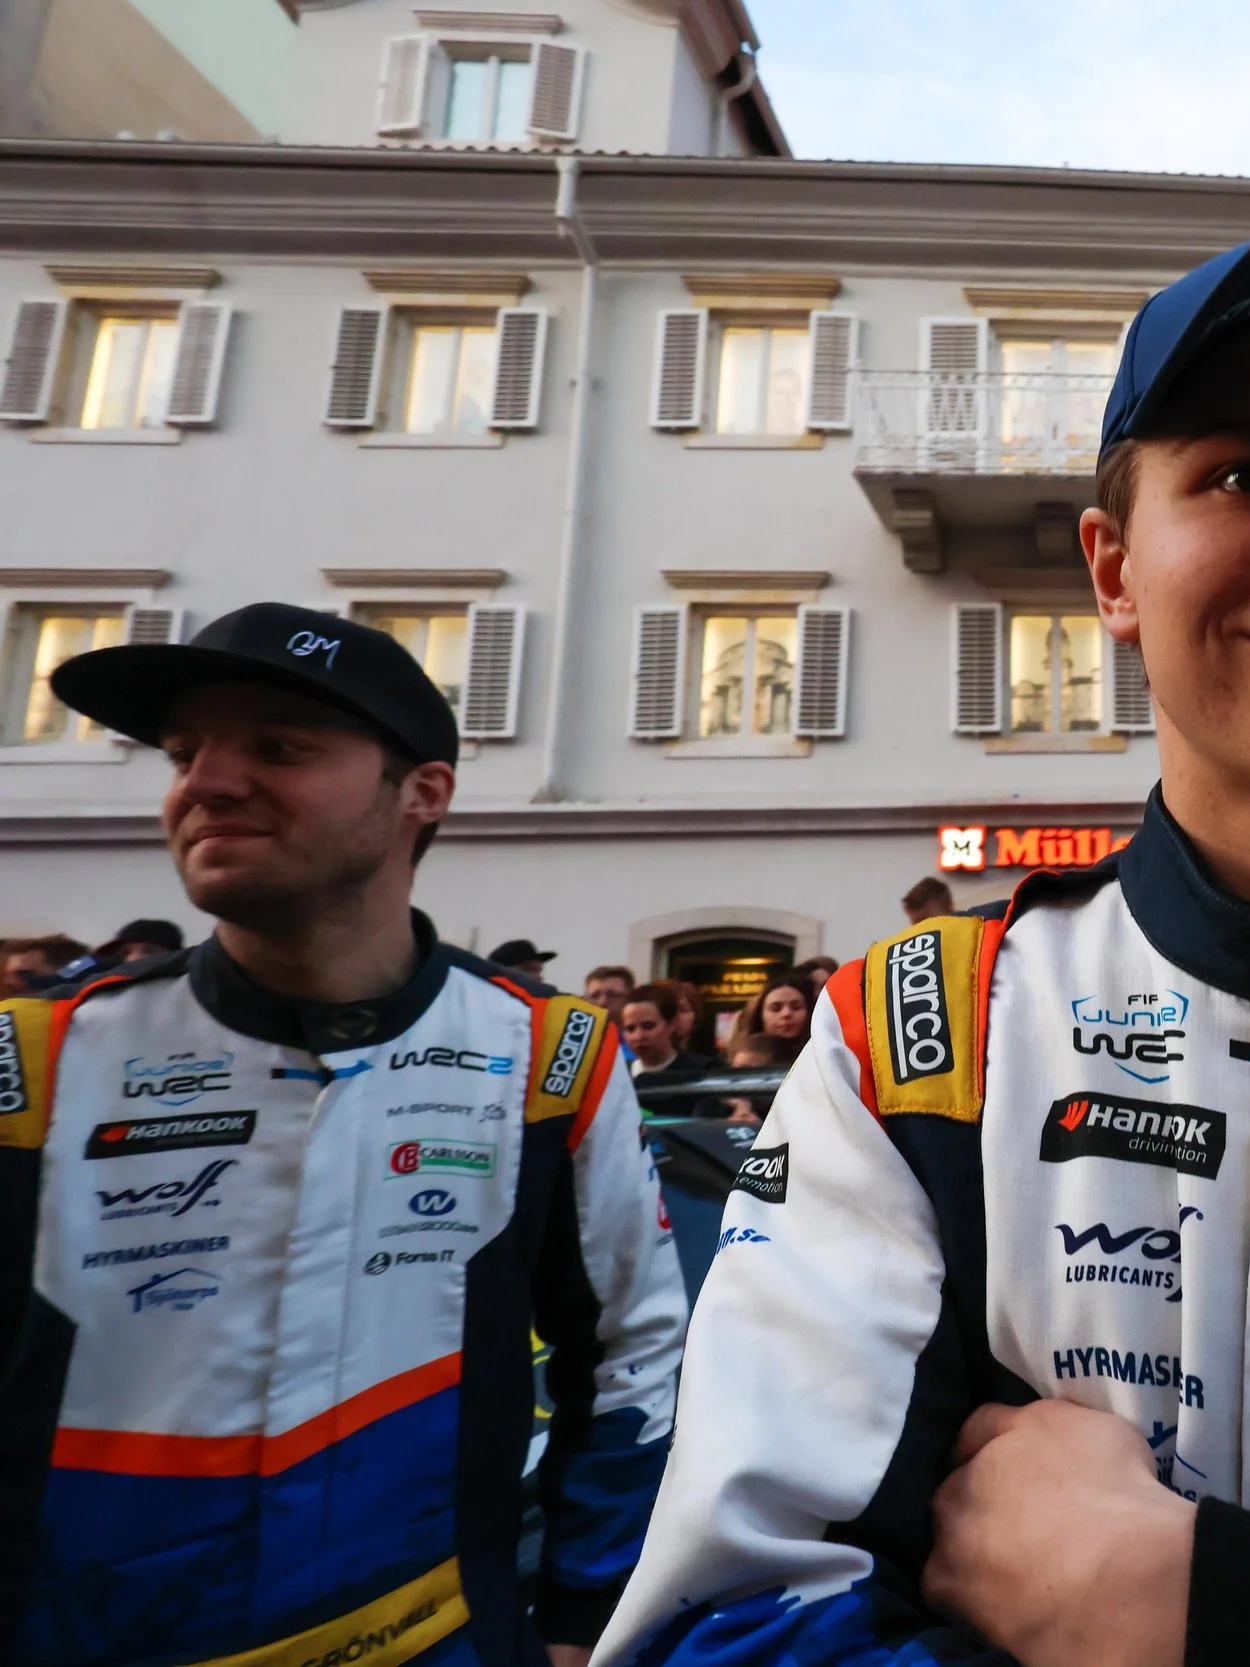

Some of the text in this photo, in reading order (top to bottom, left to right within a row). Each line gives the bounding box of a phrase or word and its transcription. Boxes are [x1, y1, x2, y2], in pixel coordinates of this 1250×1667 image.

[889, 933, 947, 1072] sparco
[389, 1046, 514, 1075] WRC2
[545, 1010, 589, 1094] sparco
[123, 1071, 233, 1098] WRC
[416, 1193, 455, 1212] W
[1065, 1264, 1175, 1290] LUBRICANTS
